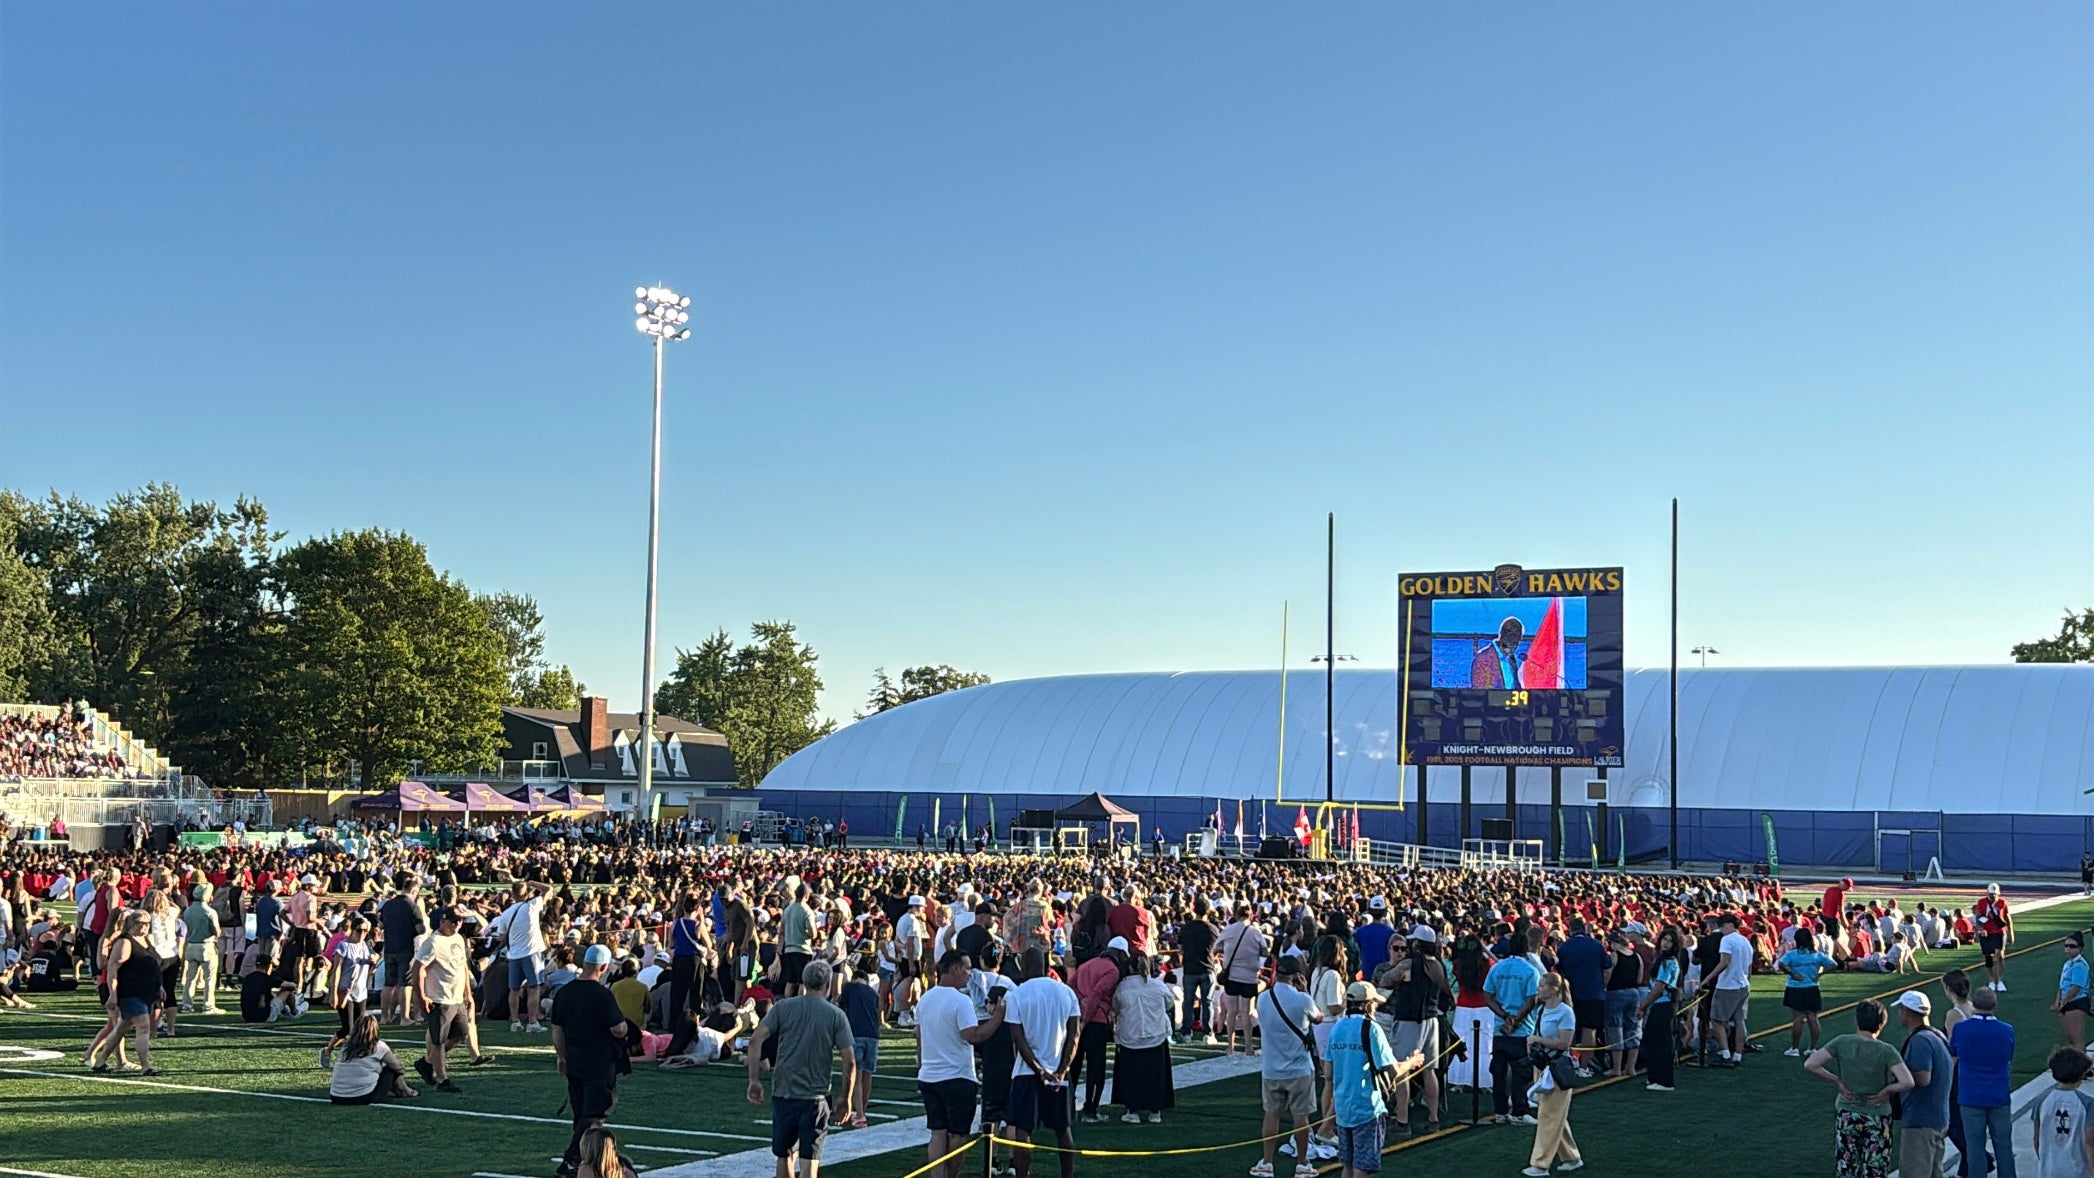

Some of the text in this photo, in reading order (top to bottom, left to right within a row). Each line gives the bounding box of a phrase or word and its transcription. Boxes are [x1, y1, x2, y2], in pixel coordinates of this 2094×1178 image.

[1400, 571, 1621, 596] GOLDEN HAWKS
[1443, 745, 1574, 755] KNIGHT-NEWBROUGH FIELD
[1465, 756, 1502, 765] FOOTBALL
[1503, 757, 1543, 765] NATIONAL
[1544, 757, 1593, 766] CHAMPIONS
